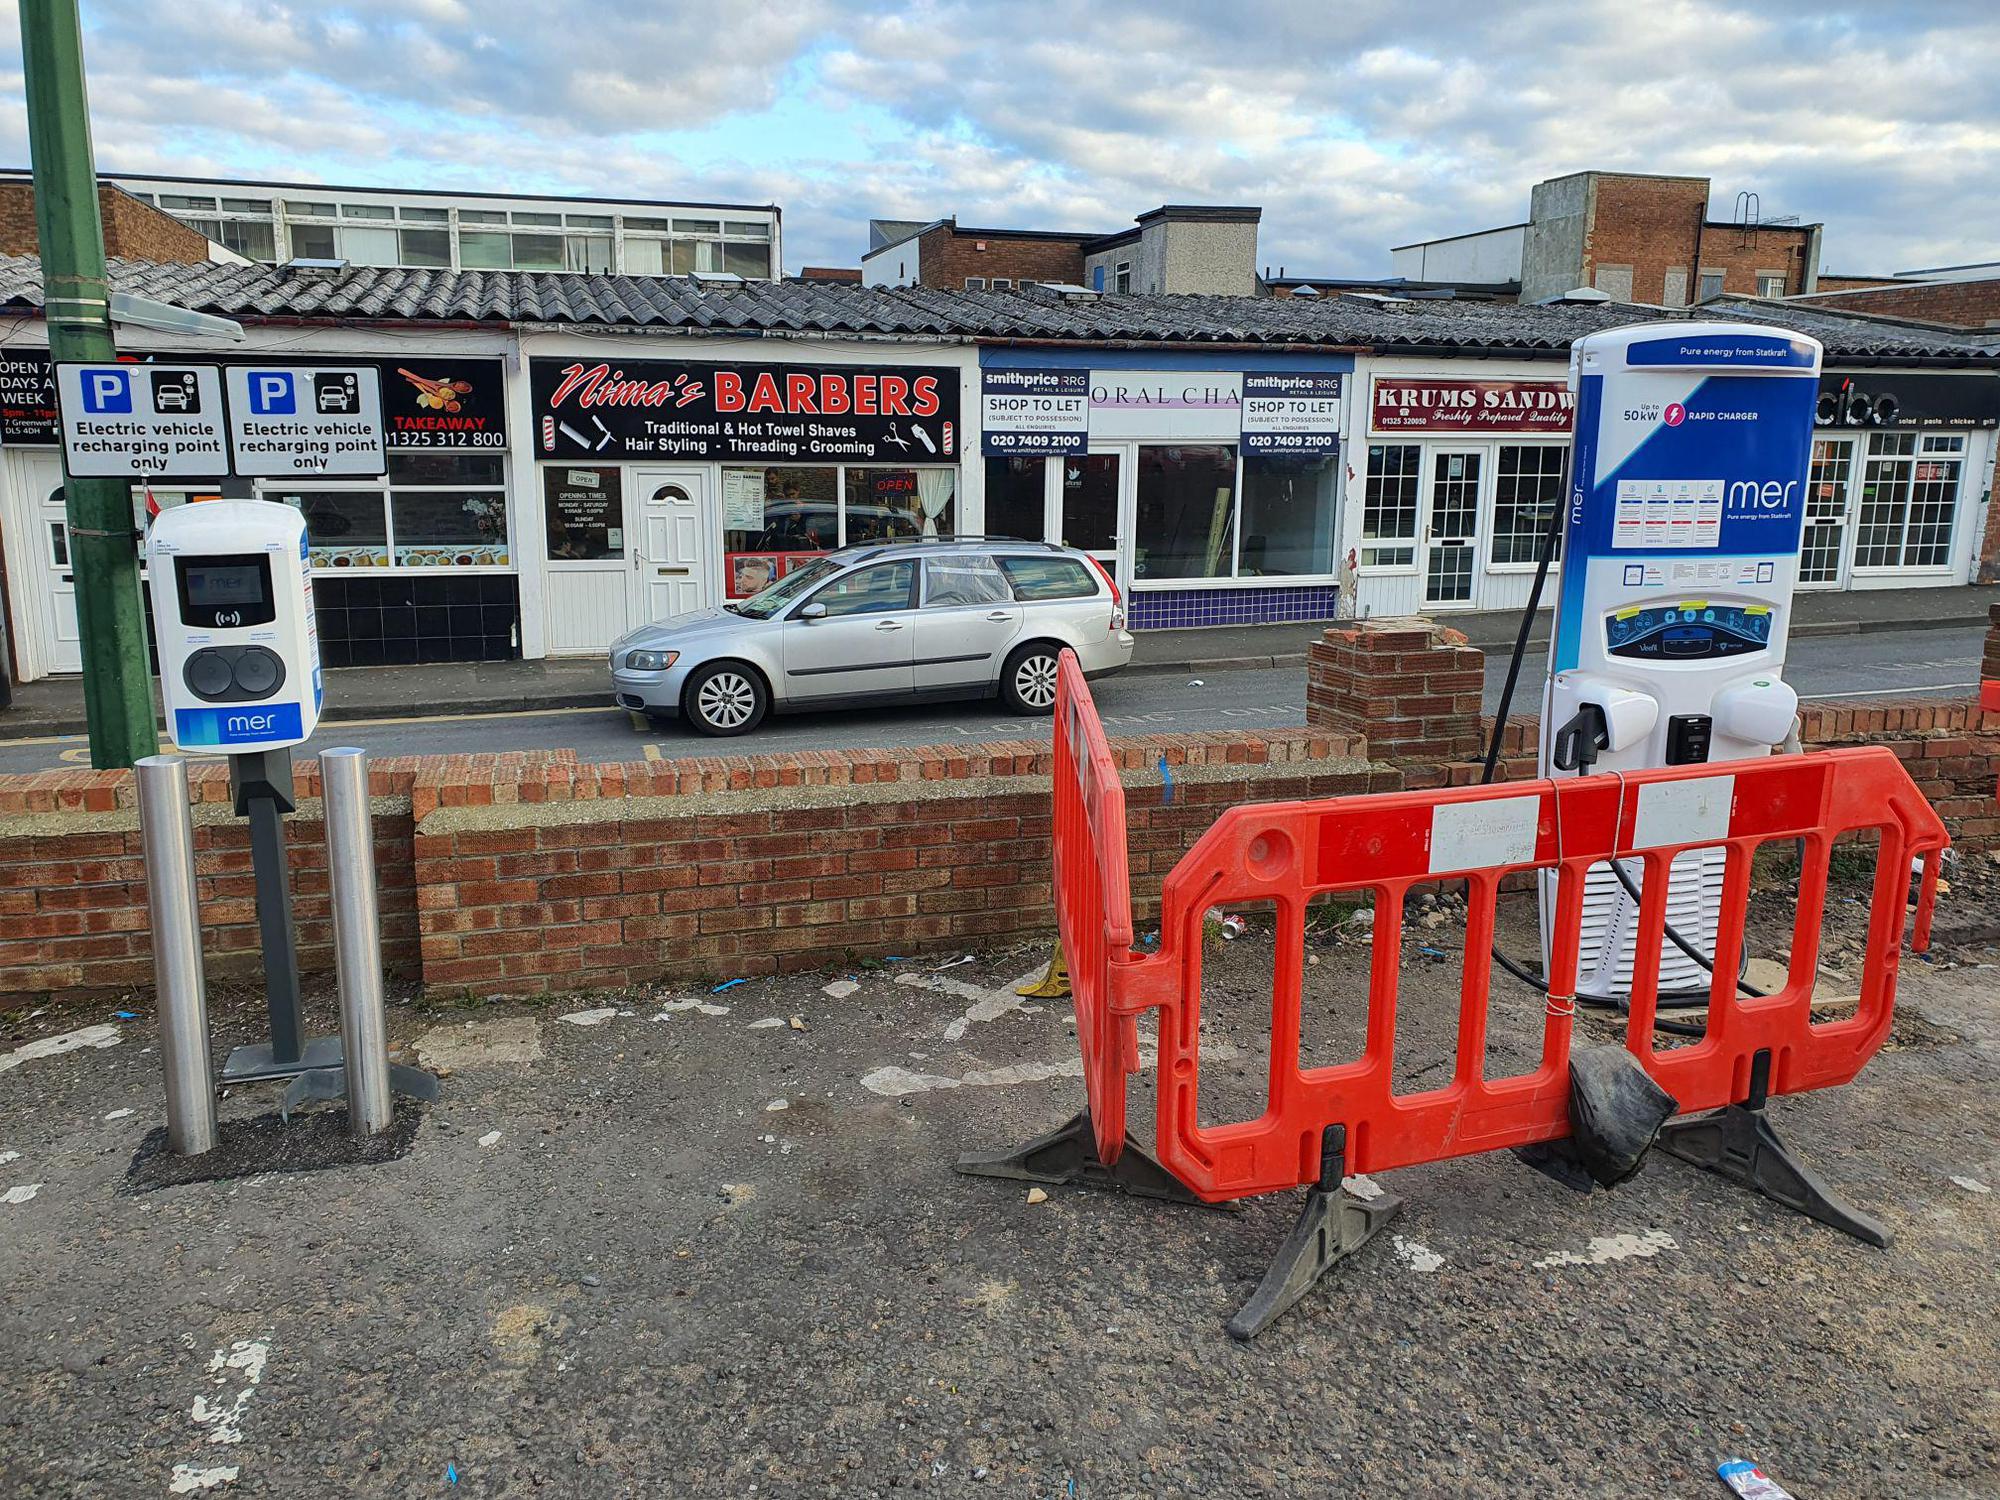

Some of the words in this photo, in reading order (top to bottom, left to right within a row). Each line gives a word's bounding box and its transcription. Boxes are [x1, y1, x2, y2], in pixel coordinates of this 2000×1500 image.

[1681, 347, 1701, 356] Pure
[1704, 348, 1734, 357] energy
[1736, 348, 1754, 356] from
[1756, 348, 1787, 357] Statkraft
[0, 361, 38, 374] OPEN
[43, 362, 51, 374] 7
[1, 377, 39, 389] DAYS
[43, 378, 54, 389] A
[986, 372, 1058, 388] smithprice
[1060, 376, 1086, 386] RRG
[1246, 376, 1314, 391] smithprice
[1316, 380, 1338, 388] RRG
[93, 375, 123, 409] P
[259, 377, 288, 410] P
[551, 363, 706, 408] Nima's
[714, 371, 940, 416] BARBERS
[1091, 386, 1171, 404] ORAL
[1182, 388, 1240, 404] CHA
[2, 392, 45, 404] WEEK
[990, 398, 1028, 410] SHOP
[1032, 399, 1052, 411] TO
[1056, 400, 1082, 412] LET
[1377, 388, 1477, 408] KRUMS
[1814, 376, 1900, 426] cibo
[1249, 402, 1284, 412] SHOP
[1289, 402, 1306, 412] TO
[1311, 402, 1334, 413] LET
[12, 419, 52, 427] Greenwell
[394, 417, 486, 430] TAKEAWAY
[1432, 410, 1472, 424] Freshly
[1477, 410, 1522, 424] Prepared
[1528, 410, 1567, 425] Quality
[1688, 412, 1715, 421] RAPID
[1717, 412, 1758, 421] CHARGER
[1924, 418, 1942, 426] pasta
[76, 422, 146, 436] Electric
[152, 422, 214, 436] vehicle
[243, 422, 308, 436] Electric
[314, 422, 372, 435] vehicle
[644, 421, 720, 435] Traditional
[724, 423, 734, 435] &
[739, 423, 762, 436] Hot
[766, 423, 804, 436] Towel
[808, 424, 856, 437] Shaves
[437, 432, 468, 446] 312
[473, 432, 504, 446] 800
[990, 436, 1015, 446] 020
[1018, 436, 1049, 446] 7409
[1051, 436, 1080, 446] 2100
[1249, 436, 1271, 446] 020
[1274, 436, 1302, 446] 7409
[1304, 436, 1332, 446] 2100
[73, 439, 169, 454] recharging
[175, 439, 220, 454] point
[240, 439, 329, 454] recharging
[336, 439, 378, 453] point
[625, 438, 654, 450] Hair
[658, 438, 707, 454] Styling
[729, 438, 797, 455] Threading
[810, 440, 875, 456] Grooming
[131, 456, 168, 470] only
[293, 456, 328, 470] only
[878, 480, 913, 490] OPEN
[1728, 480, 1798, 509] mer
[1572, 484, 1584, 524] mer
[210, 576, 242, 589] mer
[228, 714, 276, 731] mer
